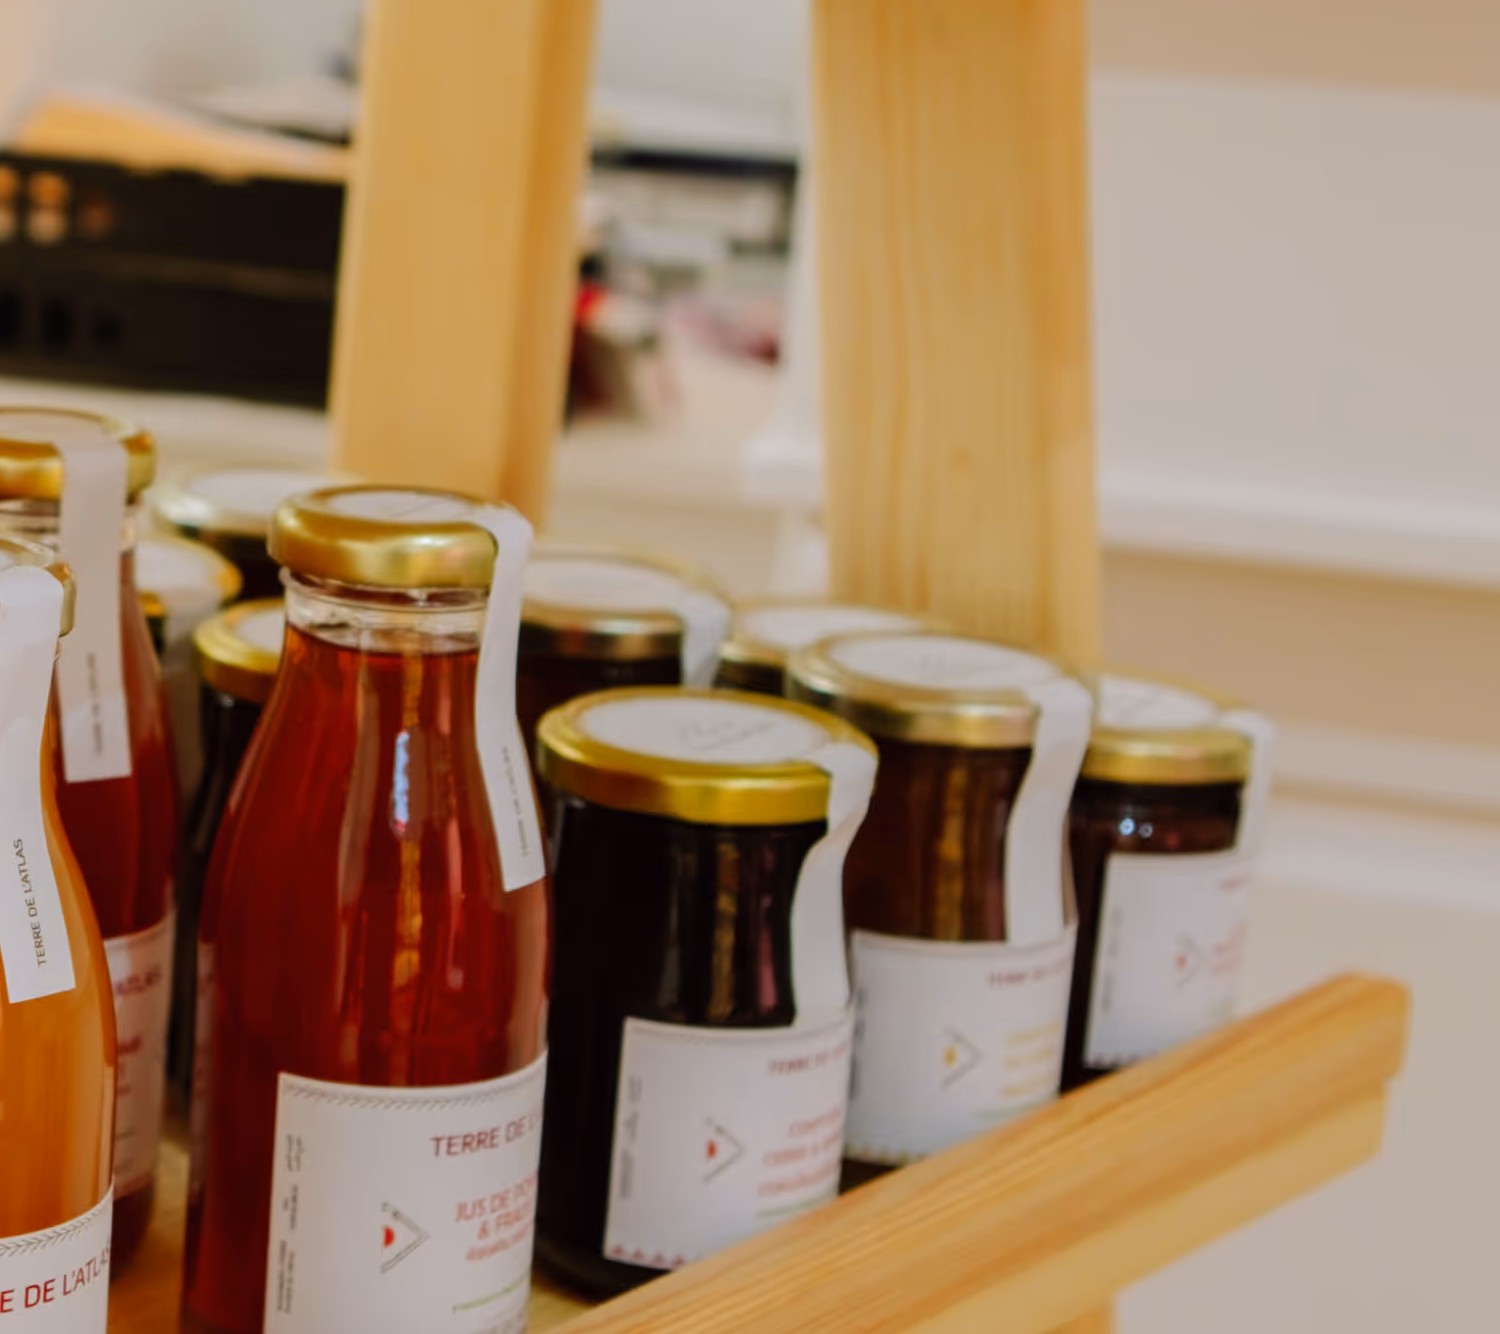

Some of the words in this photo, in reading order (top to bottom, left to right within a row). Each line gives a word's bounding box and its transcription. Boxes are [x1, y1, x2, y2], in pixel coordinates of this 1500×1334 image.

[13, 838, 33, 894] L'ATLAS
[25, 896, 38, 918] DE
[30, 920, 46, 967] TERRE
[429, 1126, 501, 1159] TERRE
[24, 1278, 57, 1309] DE
